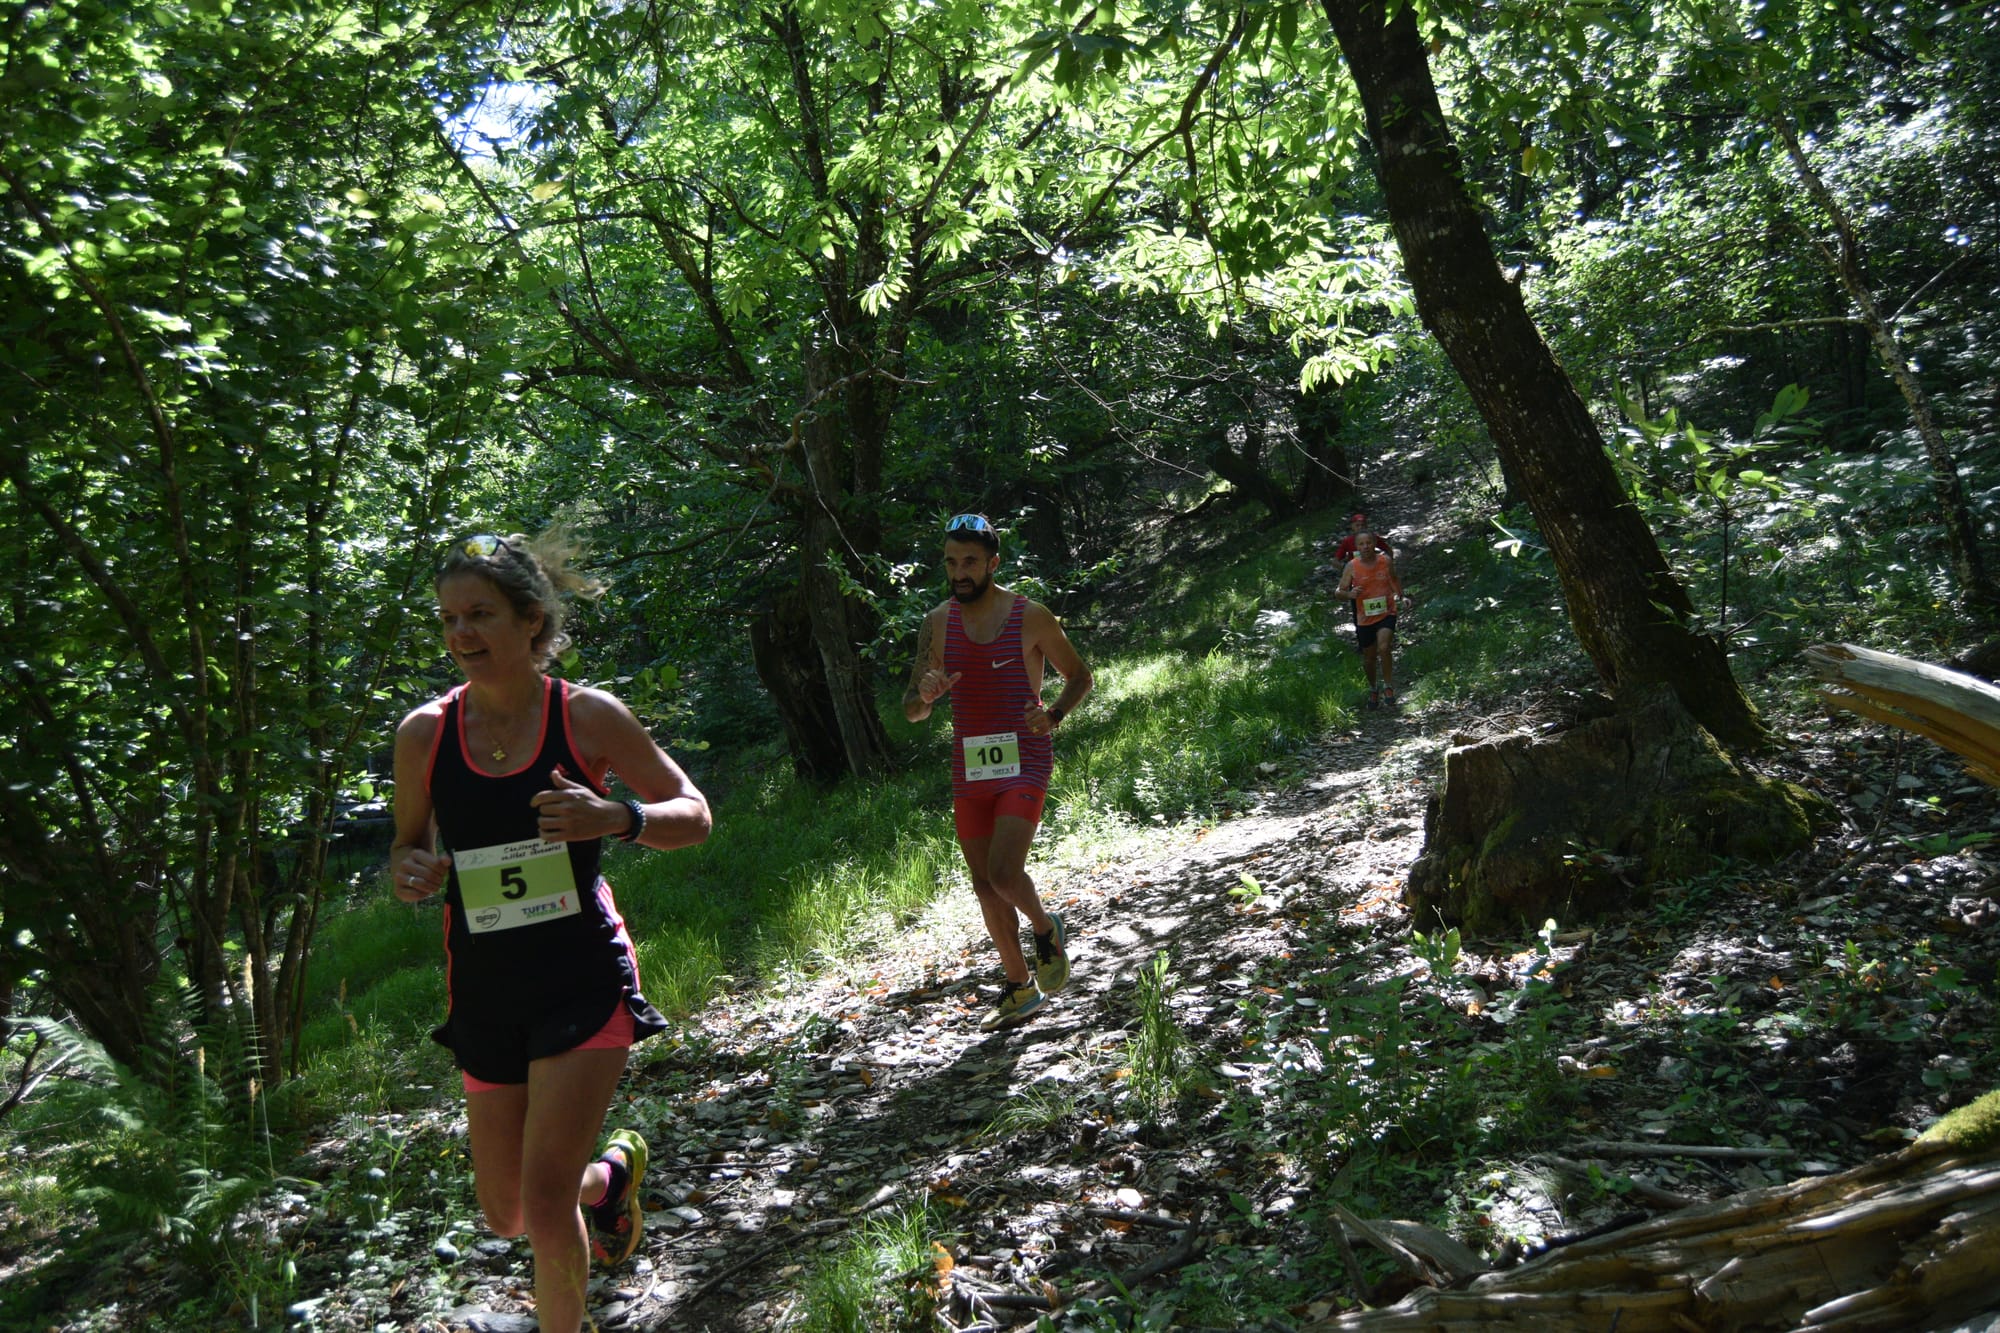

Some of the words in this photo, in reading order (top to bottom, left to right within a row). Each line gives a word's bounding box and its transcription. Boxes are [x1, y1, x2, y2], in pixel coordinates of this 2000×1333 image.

[1369, 602, 1381, 610] 64
[977, 746, 1003, 766] 10
[500, 866, 527, 900] 5
